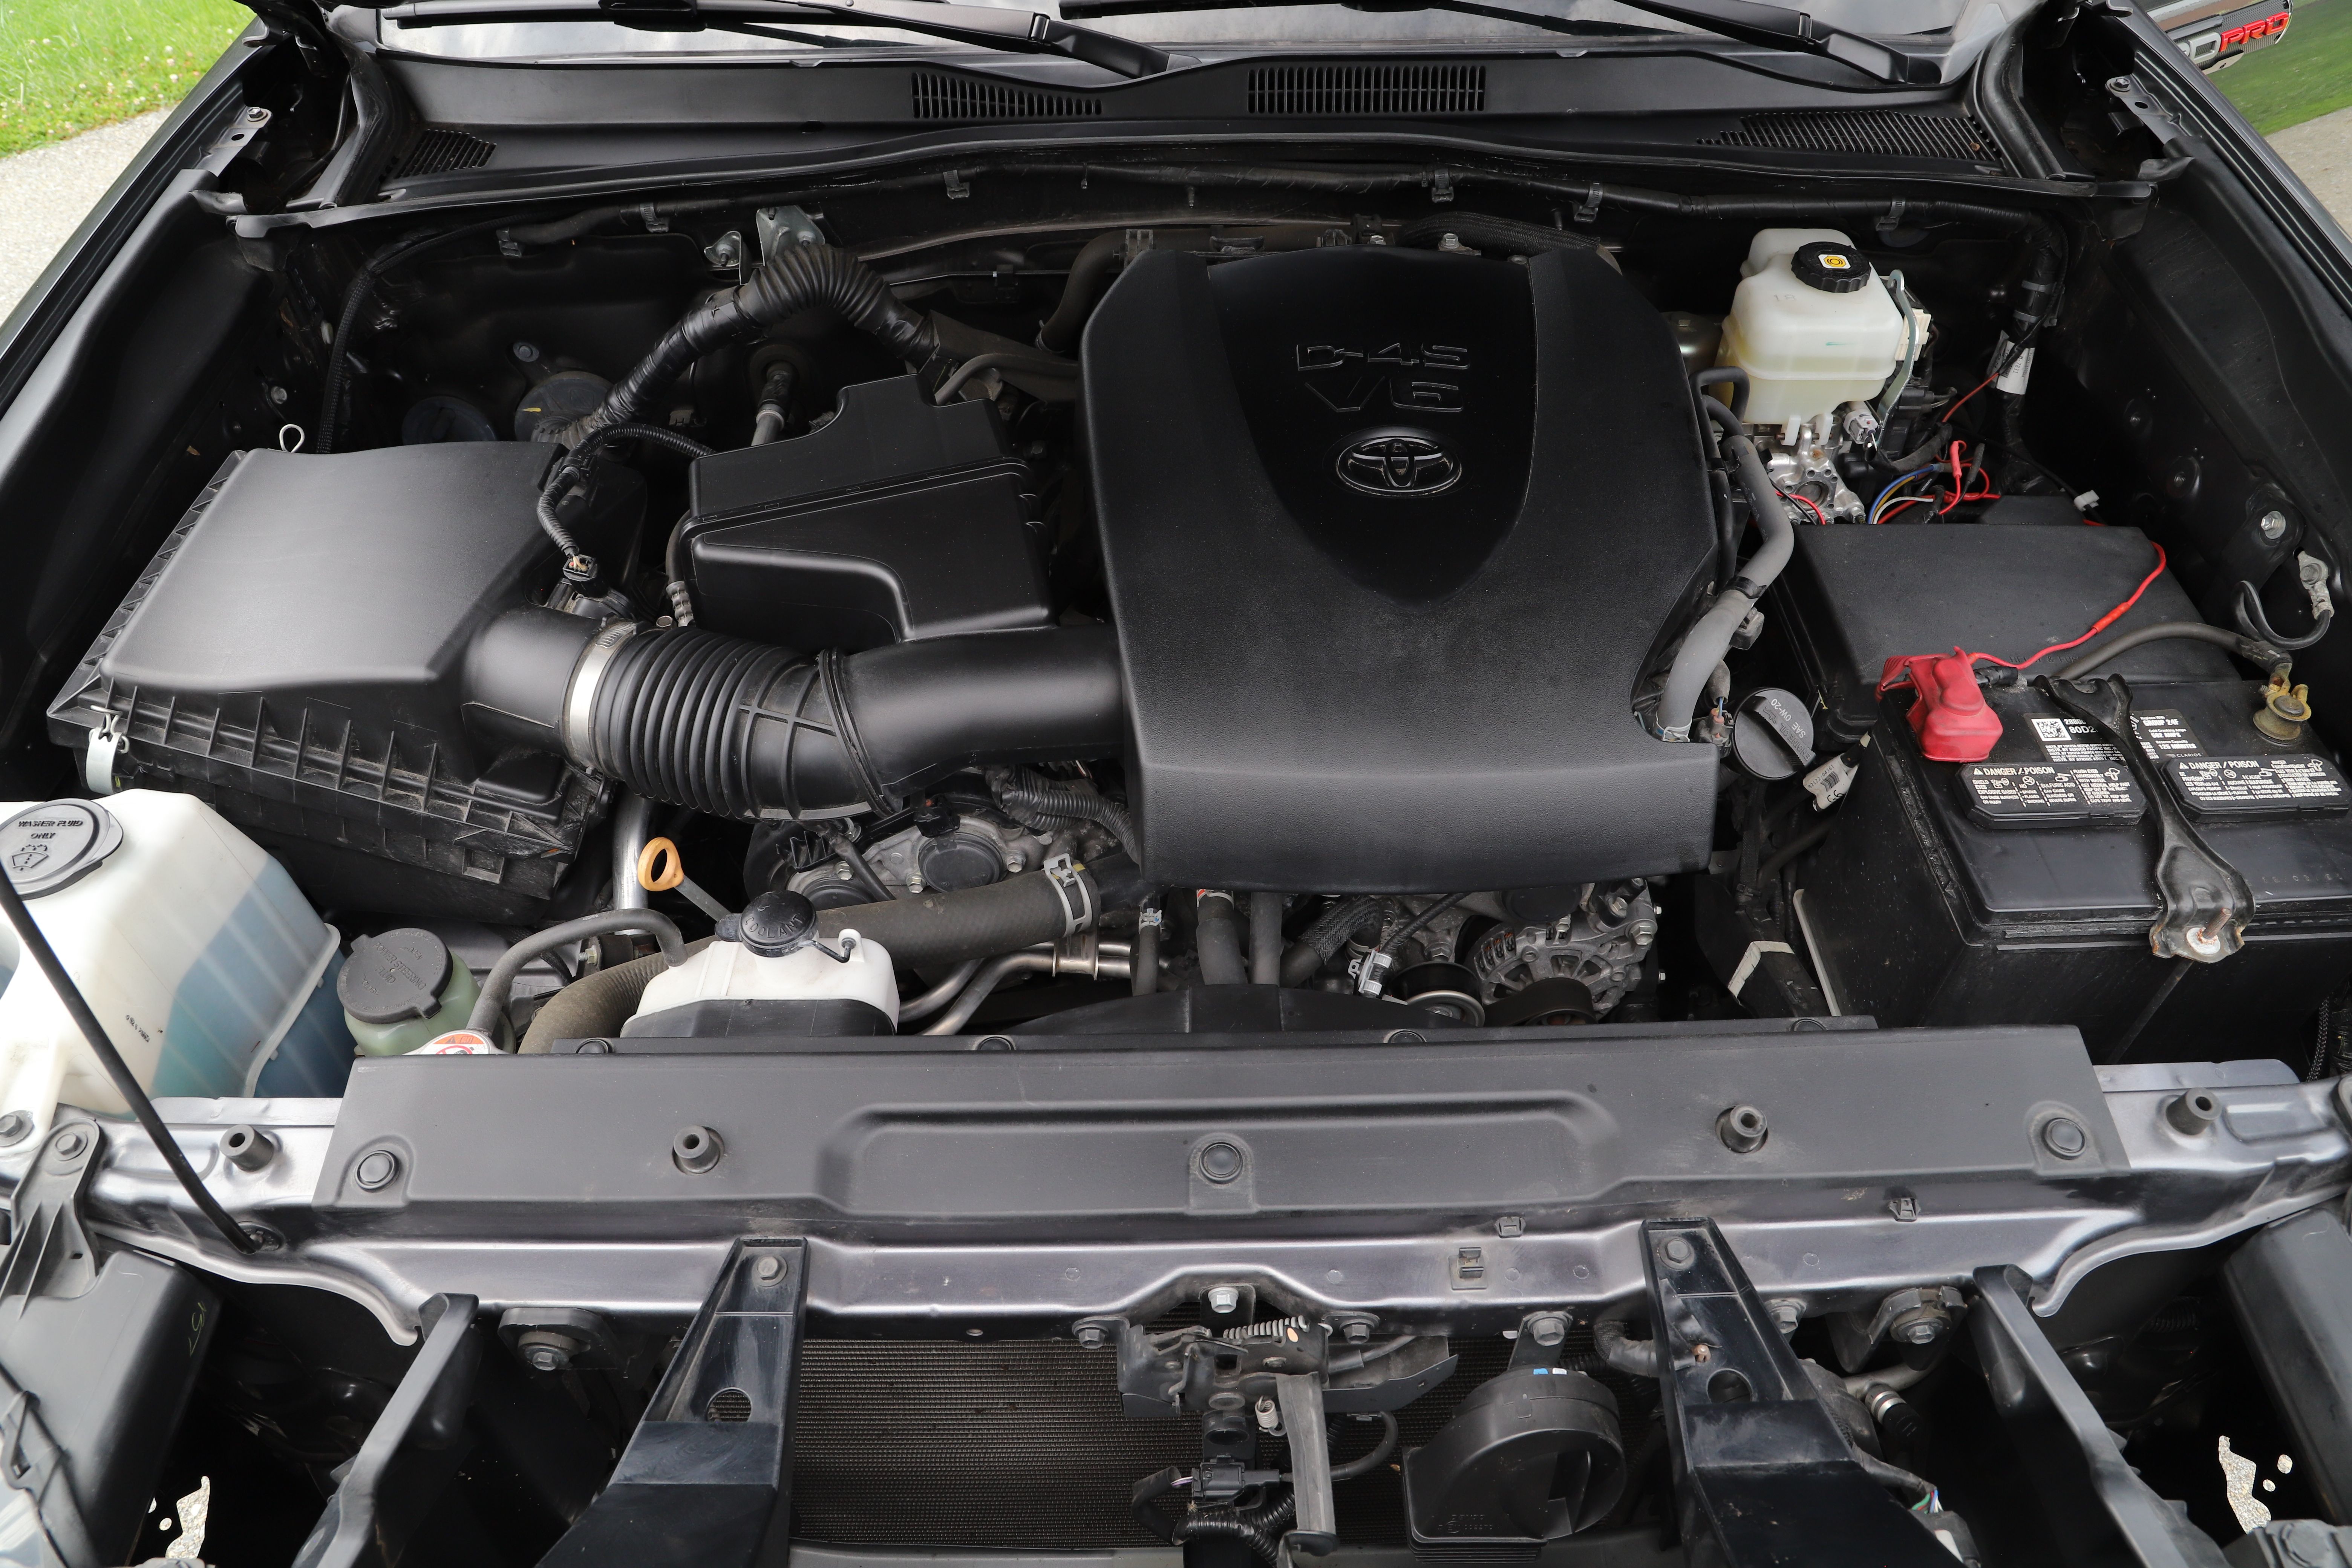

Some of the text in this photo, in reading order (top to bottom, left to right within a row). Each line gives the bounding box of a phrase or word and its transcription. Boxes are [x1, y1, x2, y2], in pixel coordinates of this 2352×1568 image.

[2177, 12, 2289, 64] D PRO
[1296, 342, 1470, 371] D-4S
[1305, 377, 1464, 413] V6
[1771, 698, 1806, 738] SAE 0W-20
[1779, 722, 1811, 761] ENGINE OIL
[1808, 764, 1834, 789] 82122-04361
[2024, 766, 2055, 775] POISON
[744, 914, 803, 938] COOLANT
[372, 941, 398, 964] POWER
[393, 960, 427, 991] STEERING
[408, 946, 423, 961] OPEN
[362, 980, 381, 995] CLOSE
[374, 965, 396, 984] FLUID
